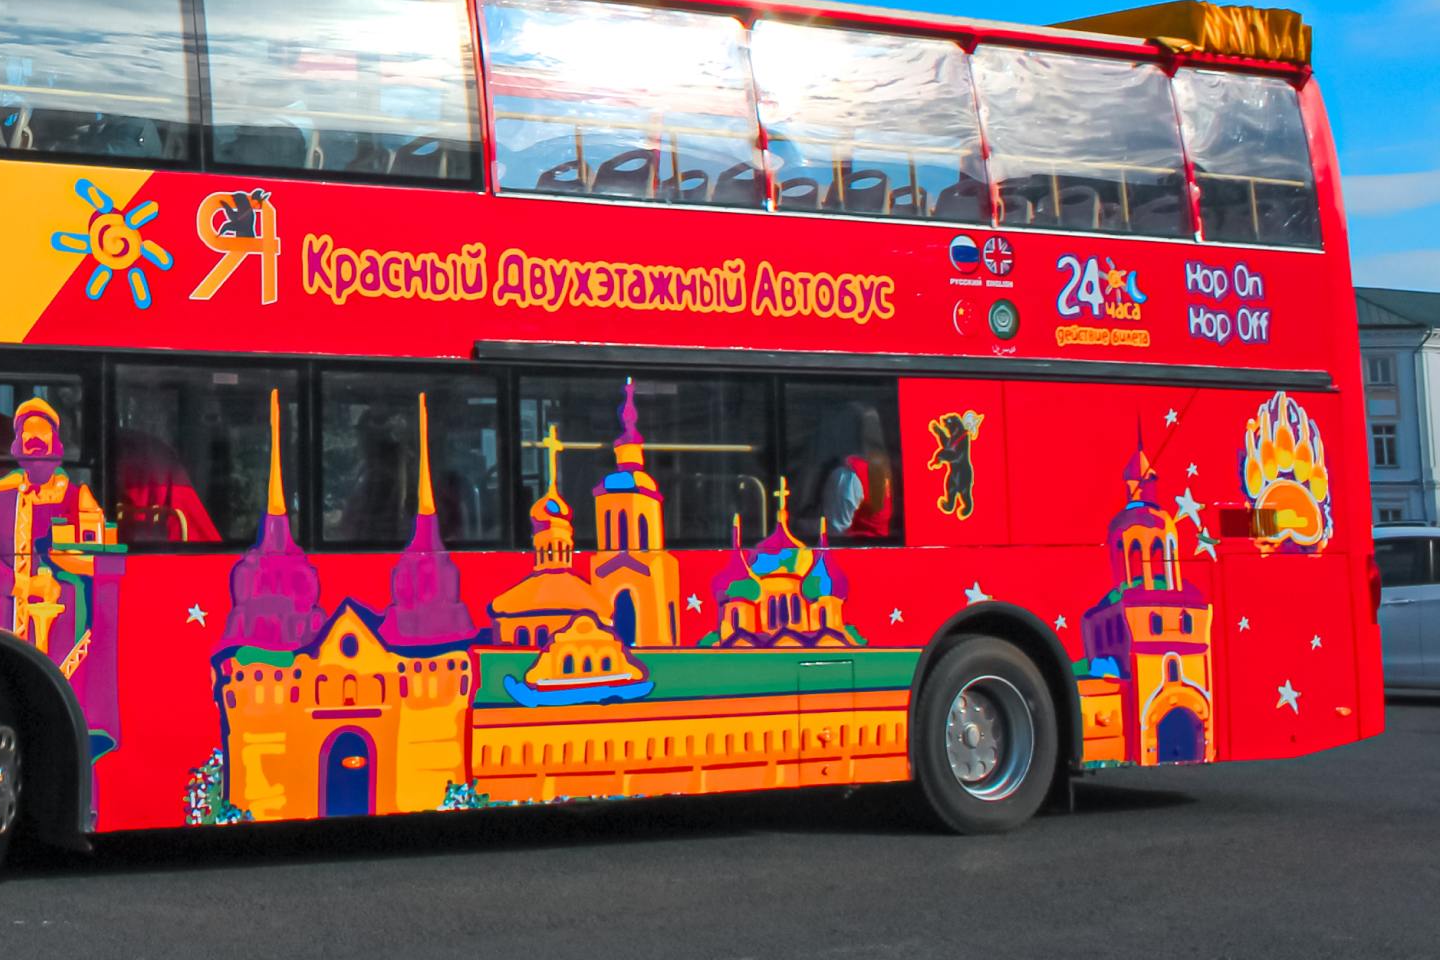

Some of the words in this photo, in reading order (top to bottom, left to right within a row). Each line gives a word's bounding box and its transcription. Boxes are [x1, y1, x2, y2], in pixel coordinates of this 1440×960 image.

[304, 235, 486, 304] Красный
[493, 248, 746, 312] Двухэтажный
[752, 261, 895, 323] Автобус
[1057, 255, 1105, 316] 24
[1105, 302, 1141, 320] часа
[1186, 262, 1228, 298] Hop
[1234, 264, 1263, 296] On
[1111, 328, 1151, 347] билета
[1189, 306, 1230, 342] Hop
[1237, 307, 1269, 341] Off
